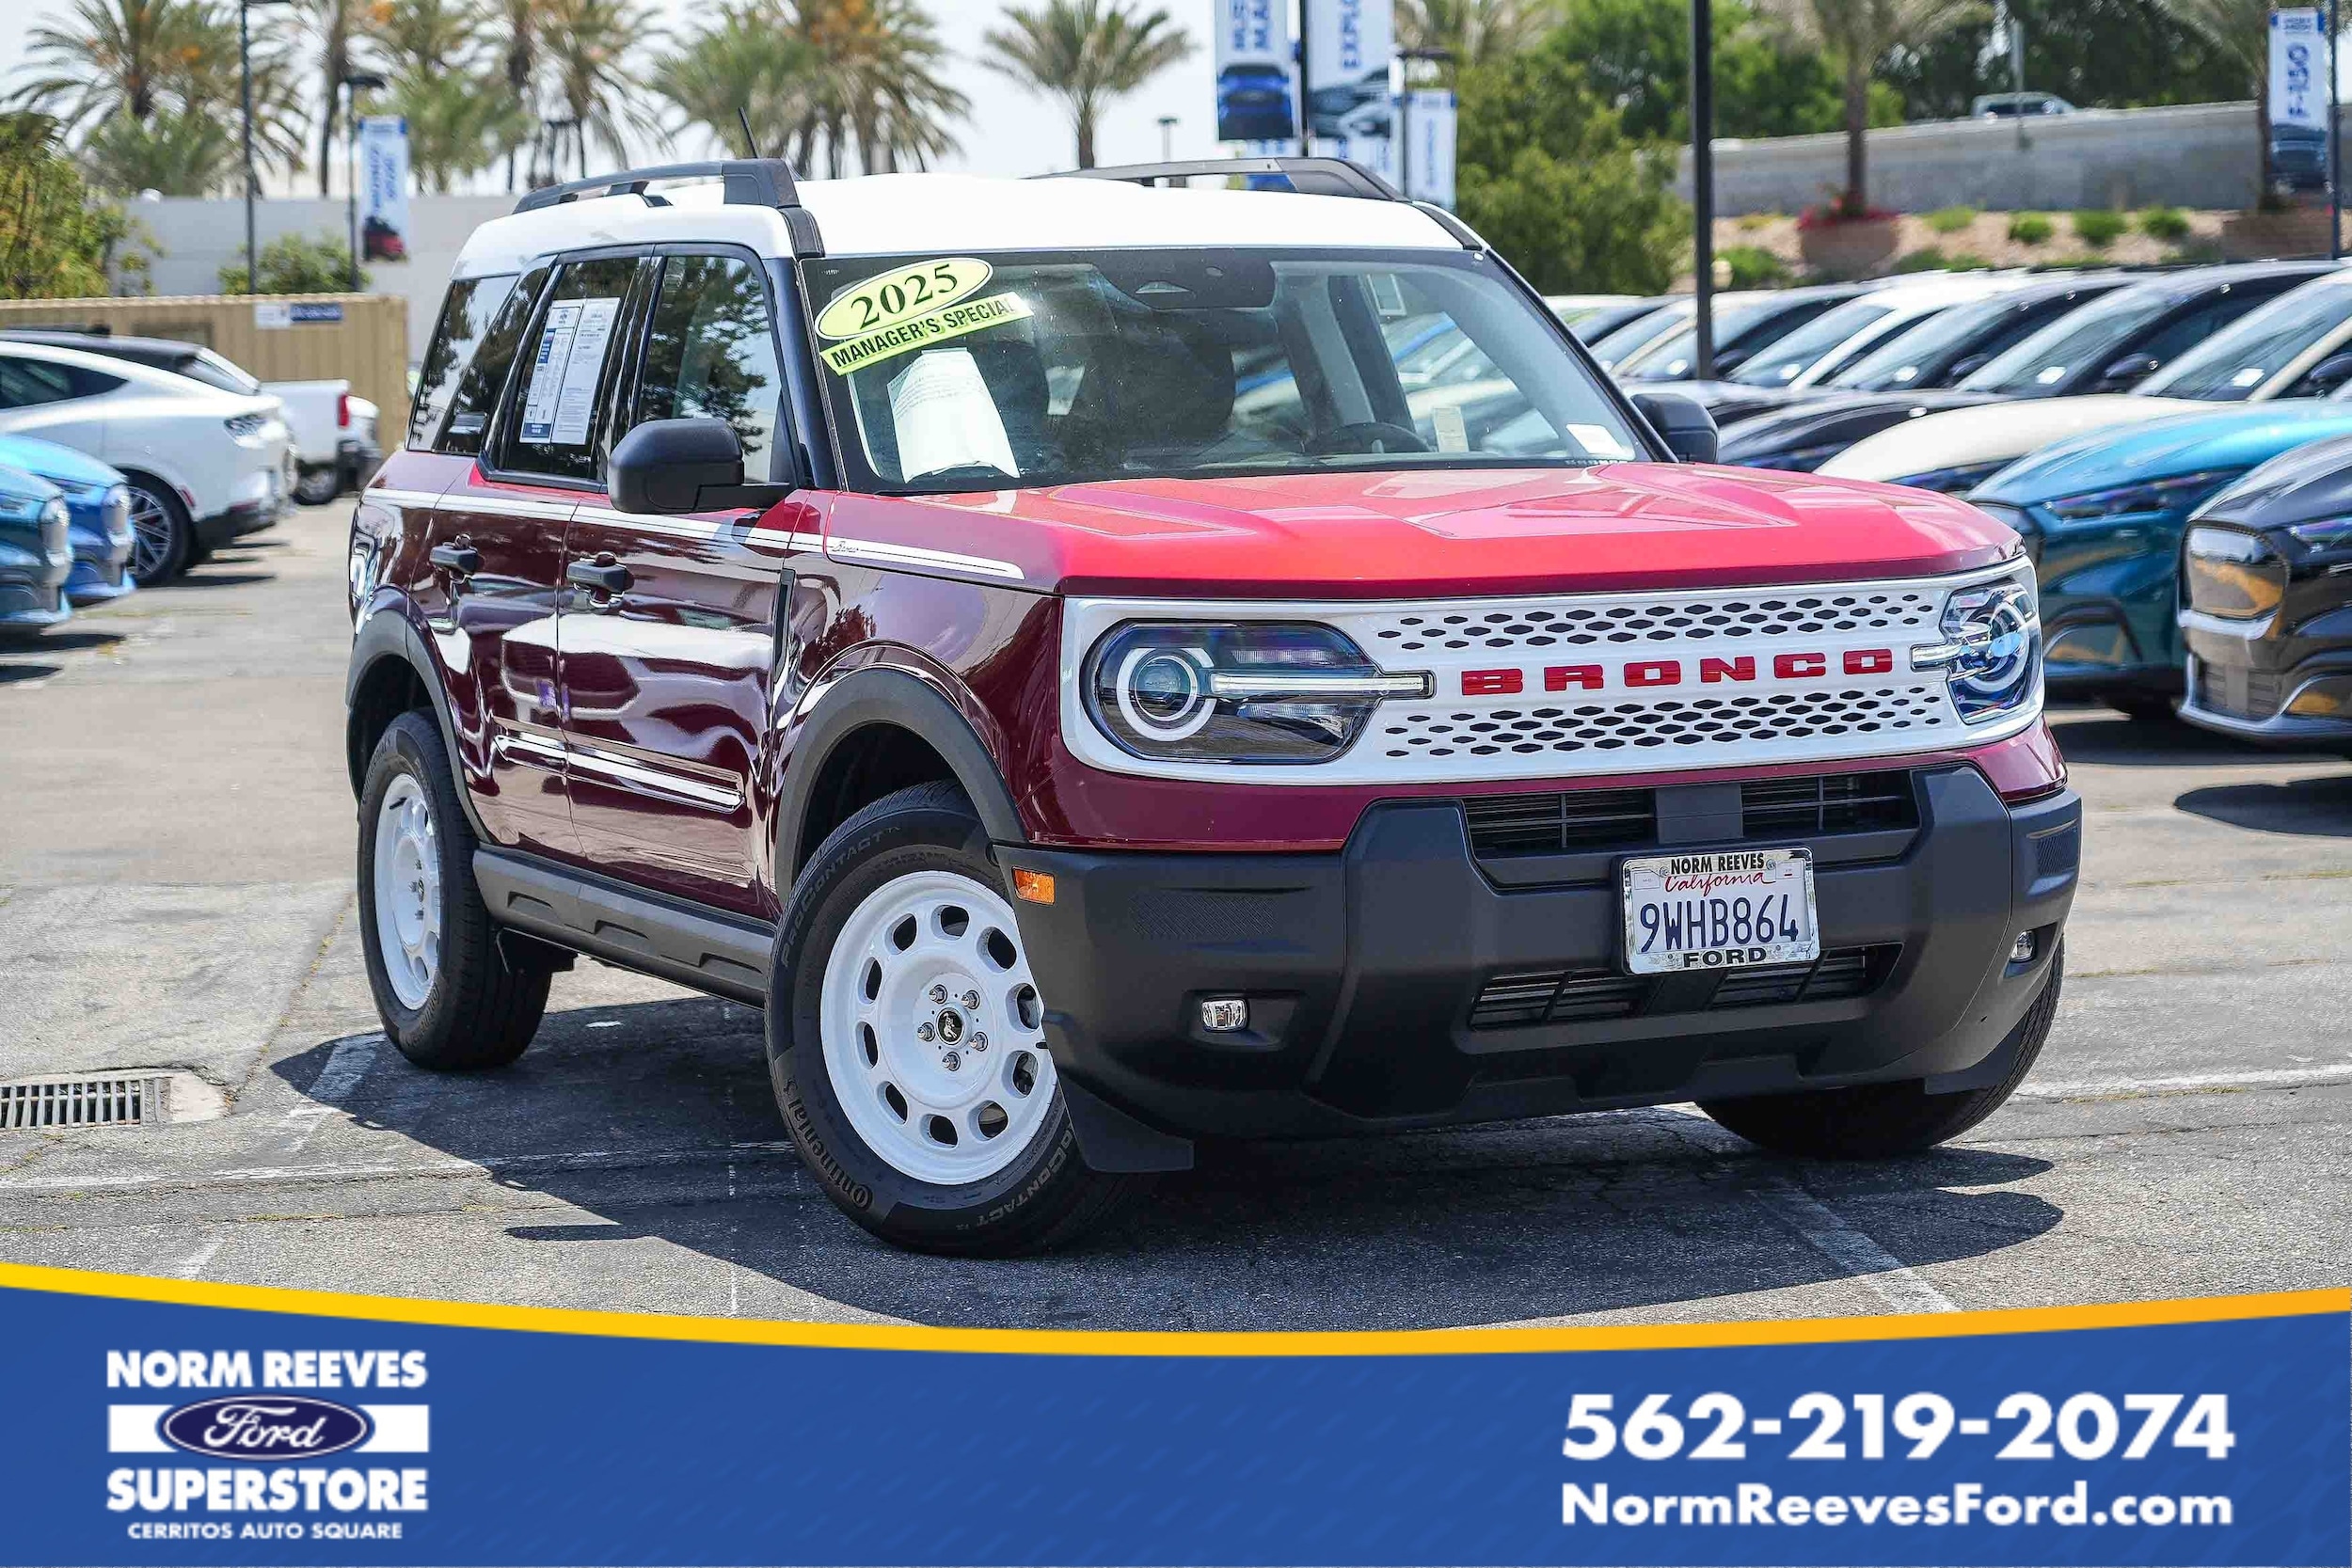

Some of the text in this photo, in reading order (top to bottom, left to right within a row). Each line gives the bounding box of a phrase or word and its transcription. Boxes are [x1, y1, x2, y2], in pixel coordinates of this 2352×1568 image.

[850, 263, 958, 329] 2025
[831, 296, 1014, 369] MANAGER'S SPECIAL
[1461, 647, 1893, 696] BRONCO
[1664, 871, 1776, 896] California
[1670, 853, 1765, 875] NORM REEVES
[1640, 894, 1799, 953] 9WHB864
[1683, 947, 1768, 968] FORD
